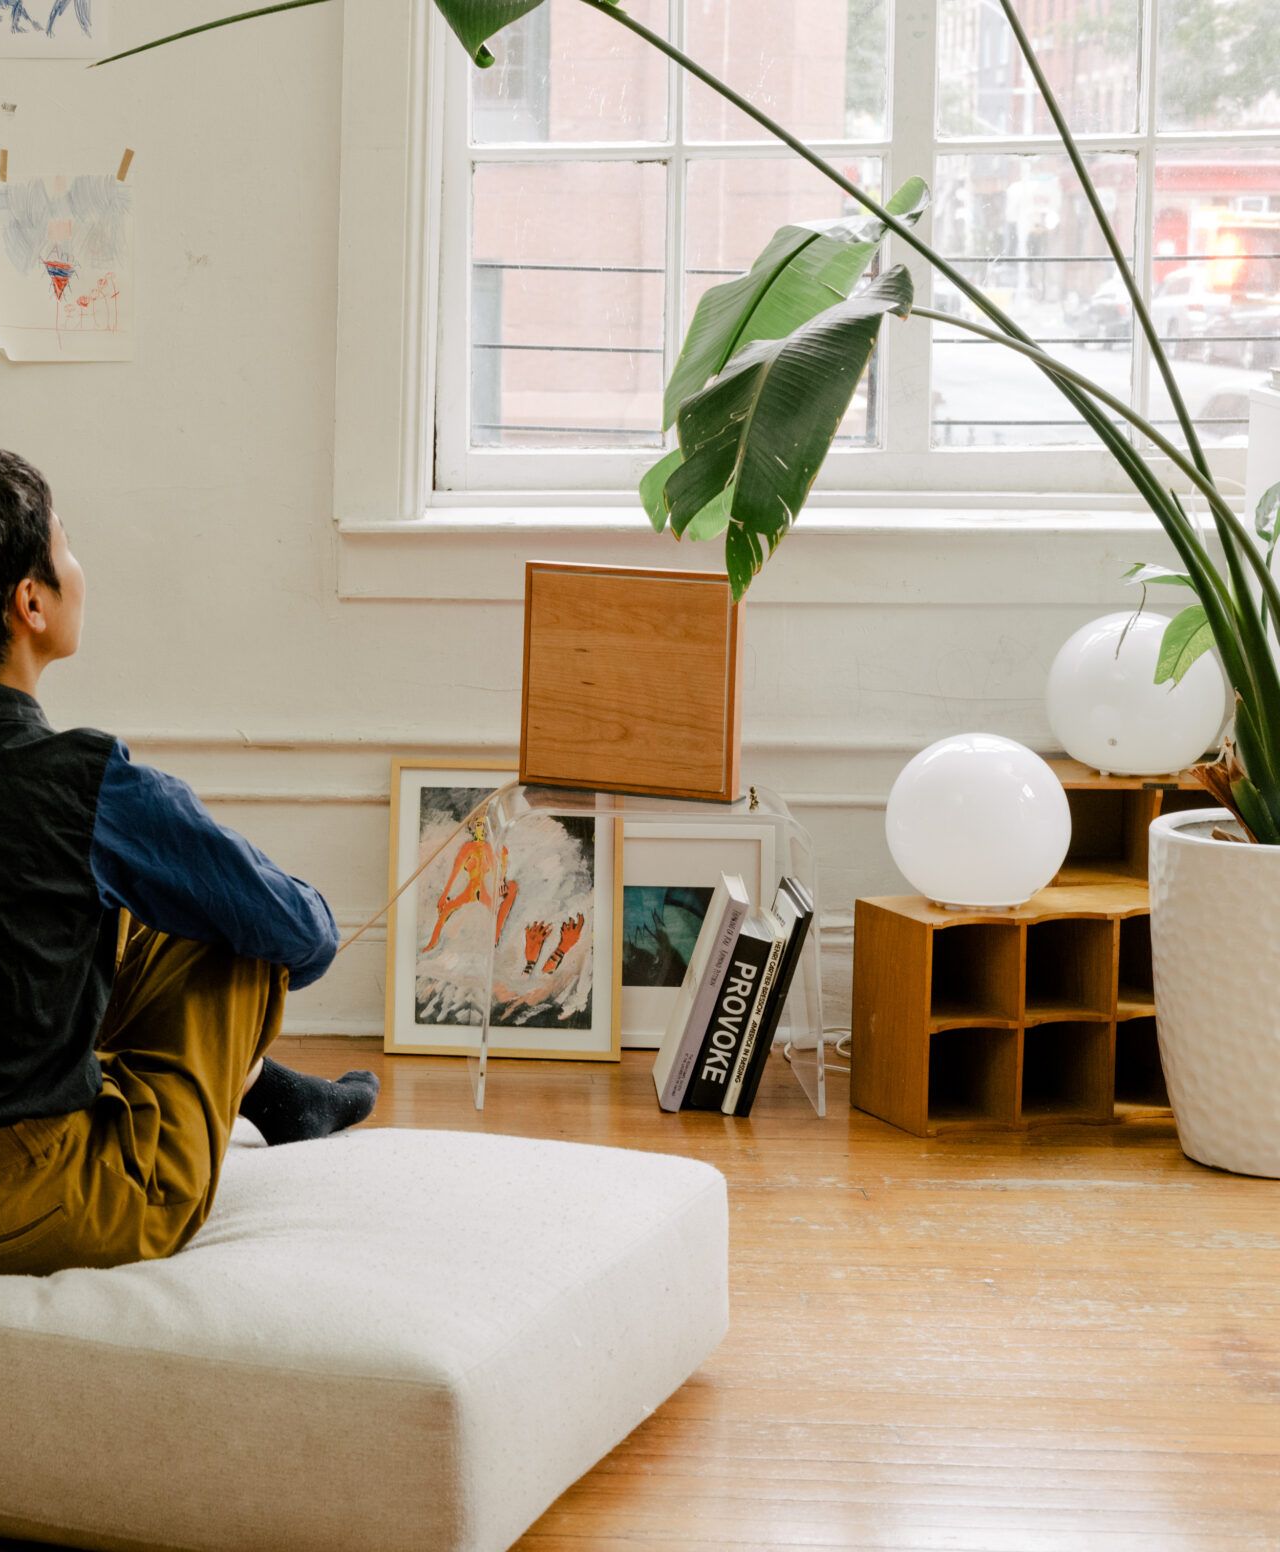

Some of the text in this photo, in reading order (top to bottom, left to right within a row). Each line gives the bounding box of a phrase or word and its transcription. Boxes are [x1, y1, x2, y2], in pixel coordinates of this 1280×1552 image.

[771, 940, 783, 961] HENRI
[701, 960, 758, 1084] PROVOKE
[745, 1019, 758, 1048] AMERICA
[743, 1048, 752, 1056] IN
[734, 1056, 748, 1084] PASSING
